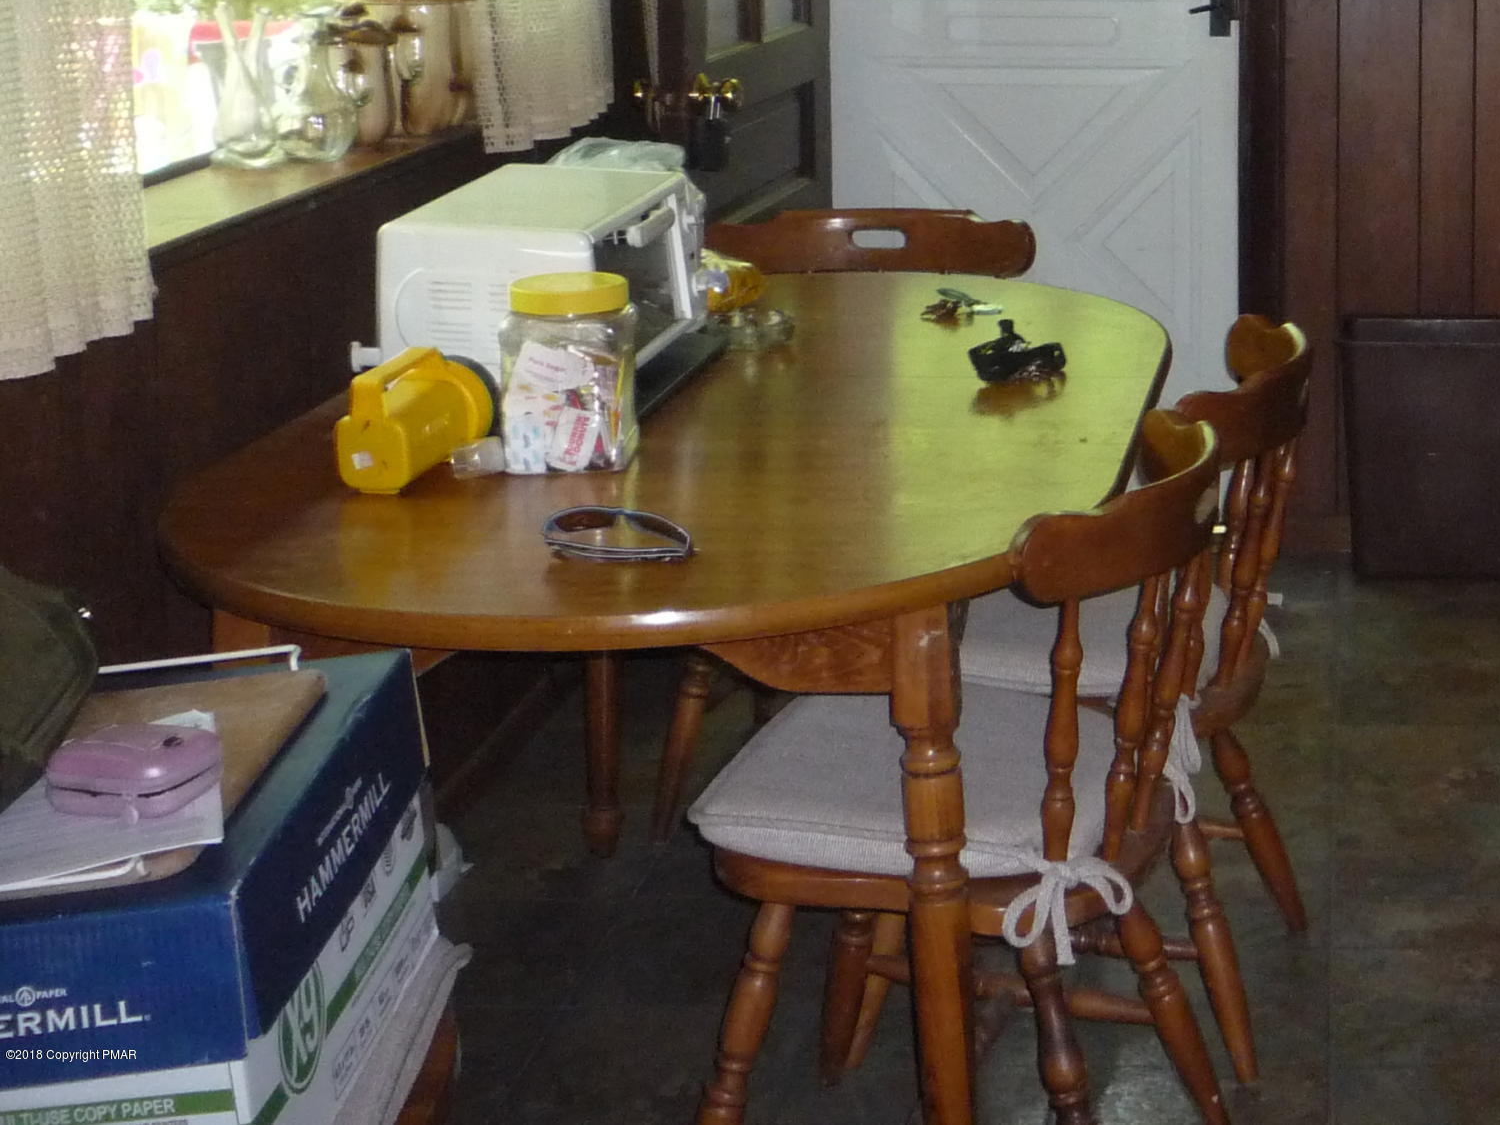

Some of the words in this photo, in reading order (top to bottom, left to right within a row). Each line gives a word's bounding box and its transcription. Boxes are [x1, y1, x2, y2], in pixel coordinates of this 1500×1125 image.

[296, 772, 392, 923] HAMMERMILL
[36, 988, 68, 1000] PAPER
[73, 1102, 118, 1124] COPY
[121, 1098, 176, 1118] PAPER
